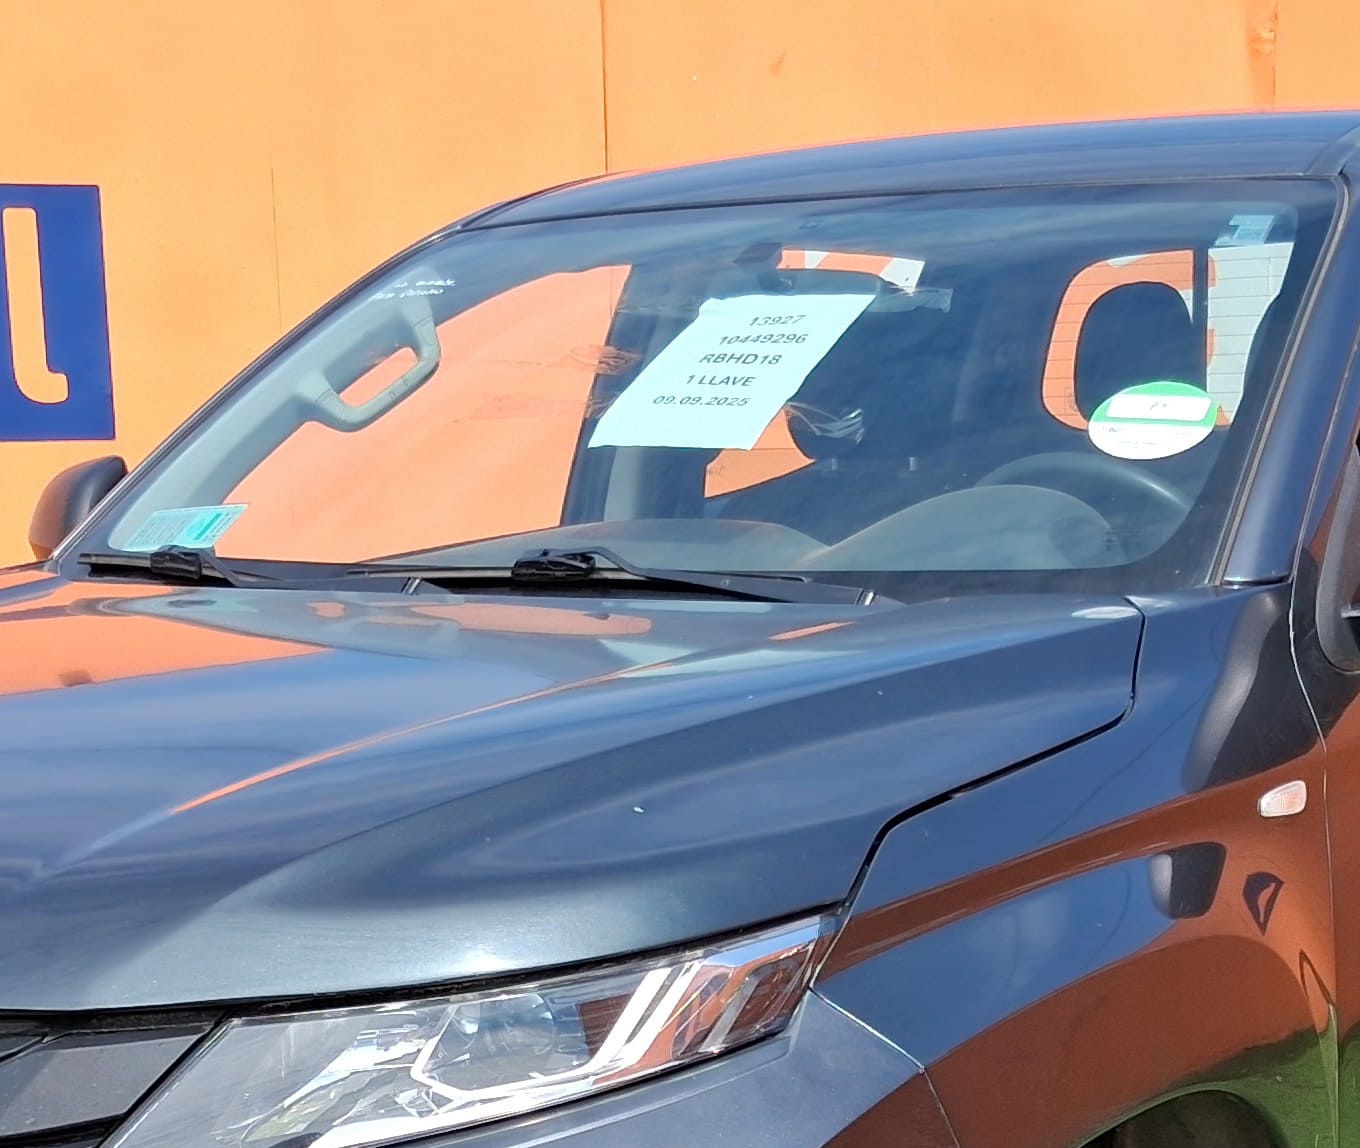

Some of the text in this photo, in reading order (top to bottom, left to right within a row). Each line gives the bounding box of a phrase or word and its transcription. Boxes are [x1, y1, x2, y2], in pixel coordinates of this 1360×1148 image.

[749, 314, 807, 326] 13927
[719, 333, 809, 345] 10449296
[698, 353, 783, 365] RBHD18
[685, 374, 757, 387] 1 LLAVE
[652, 395, 752, 407] 09.09.2025
